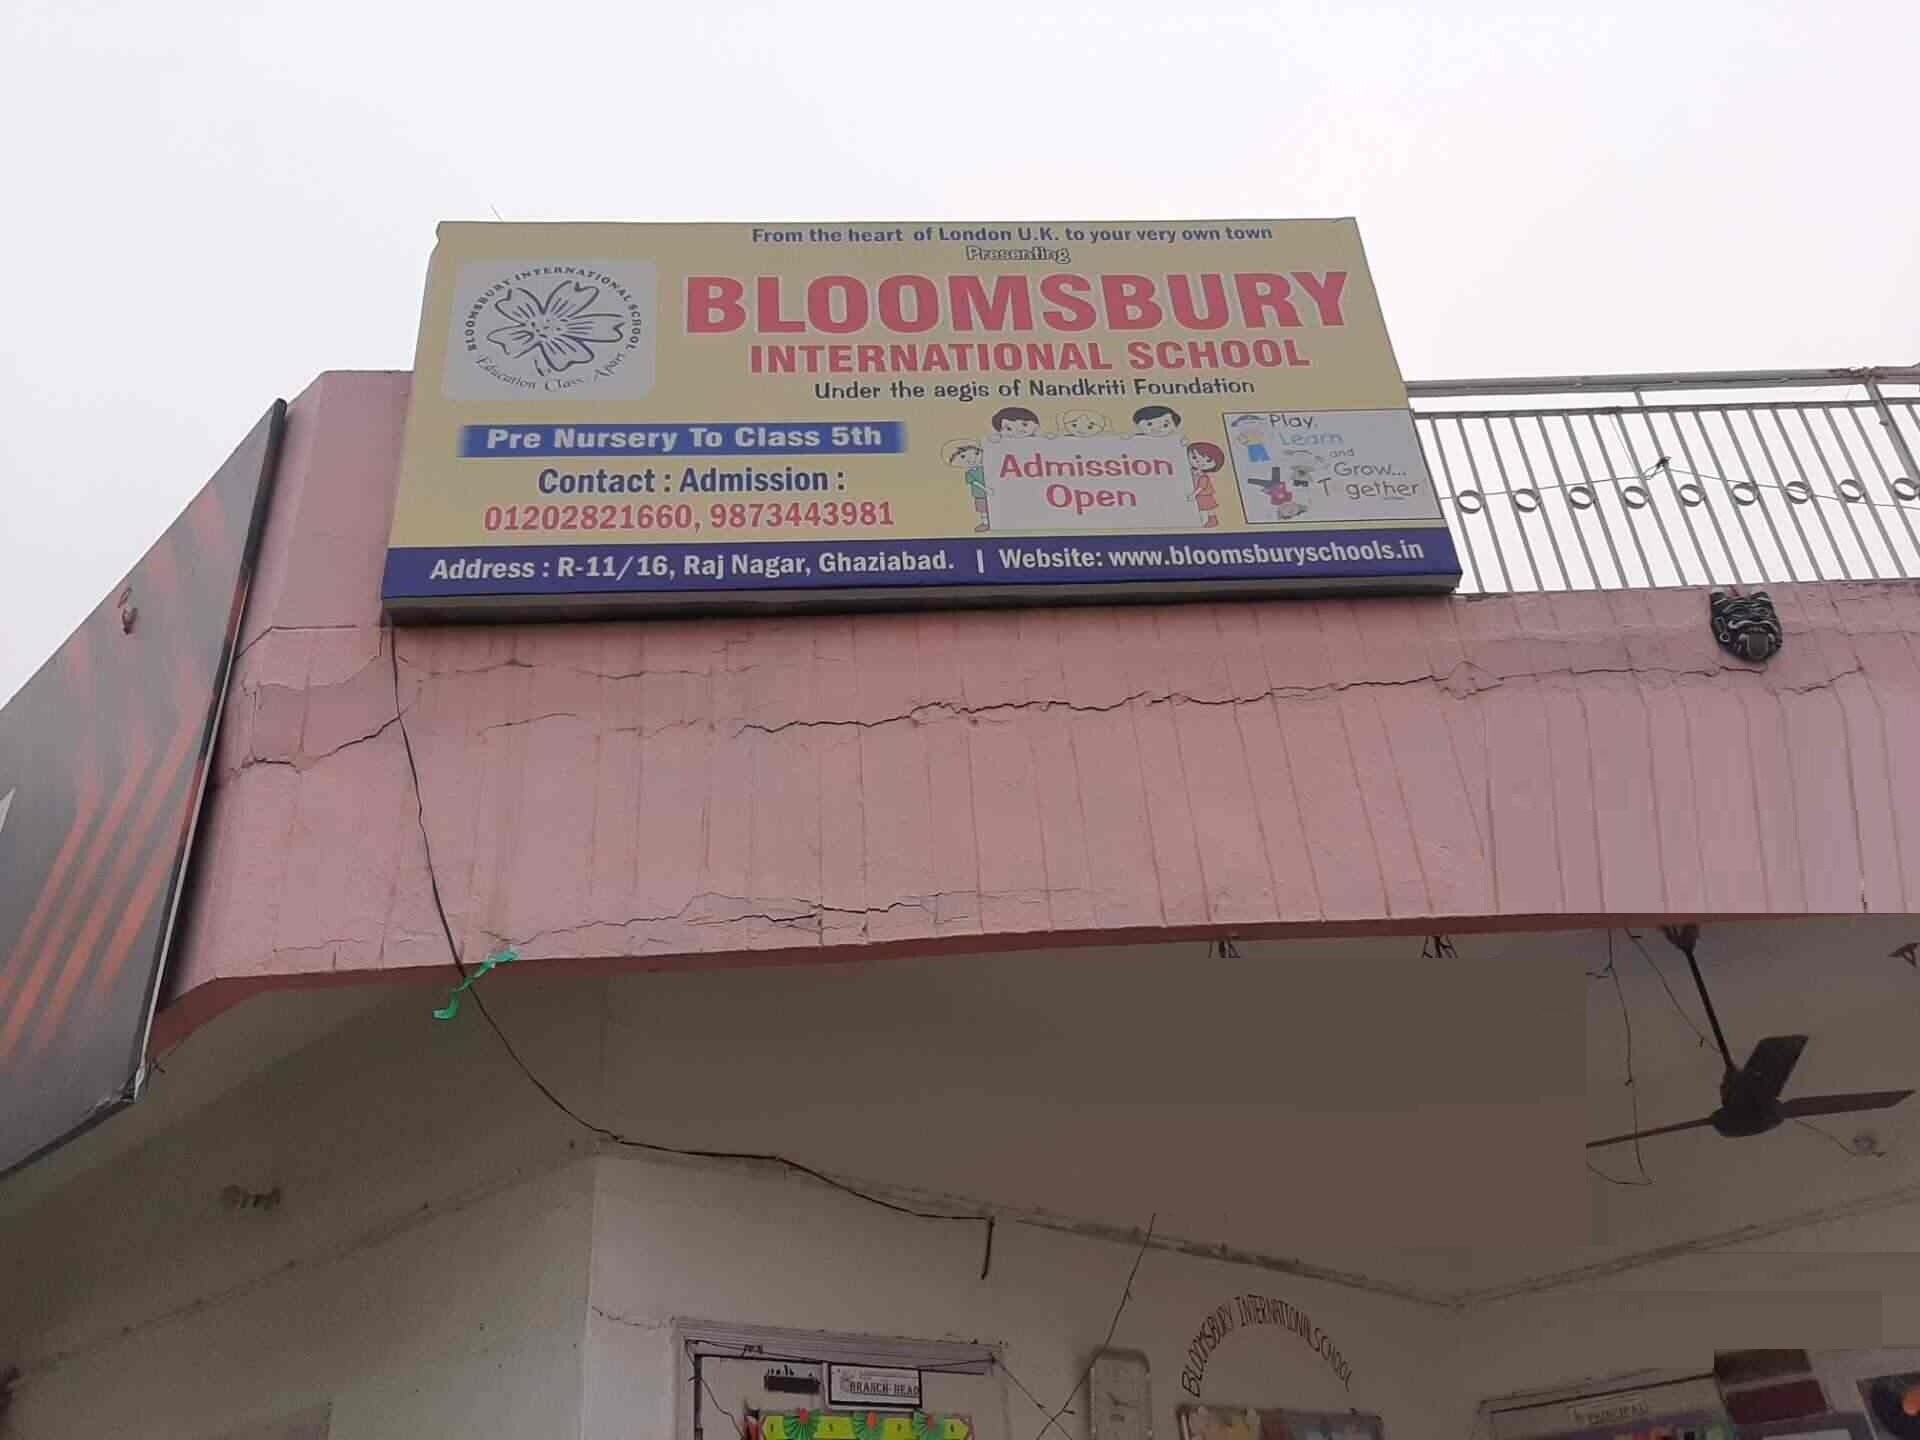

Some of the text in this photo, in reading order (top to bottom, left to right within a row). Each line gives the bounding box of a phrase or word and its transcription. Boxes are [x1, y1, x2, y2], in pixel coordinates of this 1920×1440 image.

[752, 226, 1273, 244] From the heart of London U.K. to your very own town
[966, 246, 1071, 264] Presenting
[514, 266, 632, 303] INTERNATIONAL
[687, 271, 1348, 334] BLOOMSBURY
[751, 339, 1310, 374] INTERNATIONAL SCHOOL
[475, 354, 537, 390] Education
[815, 377, 1255, 401] Under the aegis of Nandkriti Foundation
[487, 425, 881, 453] Pre Nursery To Class 5th
[1279, 431, 1344, 447] Learn
[1329, 448, 1355, 458] and
[999, 454, 1174, 479] Admission
[1334, 462, 1407, 477] Grow...
[538, 468, 656, 495] Contact
[680, 469, 828, 493] Admission
[1317, 477, 1420, 500] Tgether
[1046, 484, 1137, 514] Open
[484, 501, 895, 532] 01202821660, 9873443981
[557, 555, 675, 582] R-11/16,
[683, 554, 725, 580] Raj
[730, 554, 811, 581] Nagar,
[819, 551, 954, 575] Ghaziabad.
[999, 547, 1102, 570] Website:
[1107, 540, 1424, 568] www.bloomsburyschools.in
[849, 1380, 889, 1394] BRANCH
